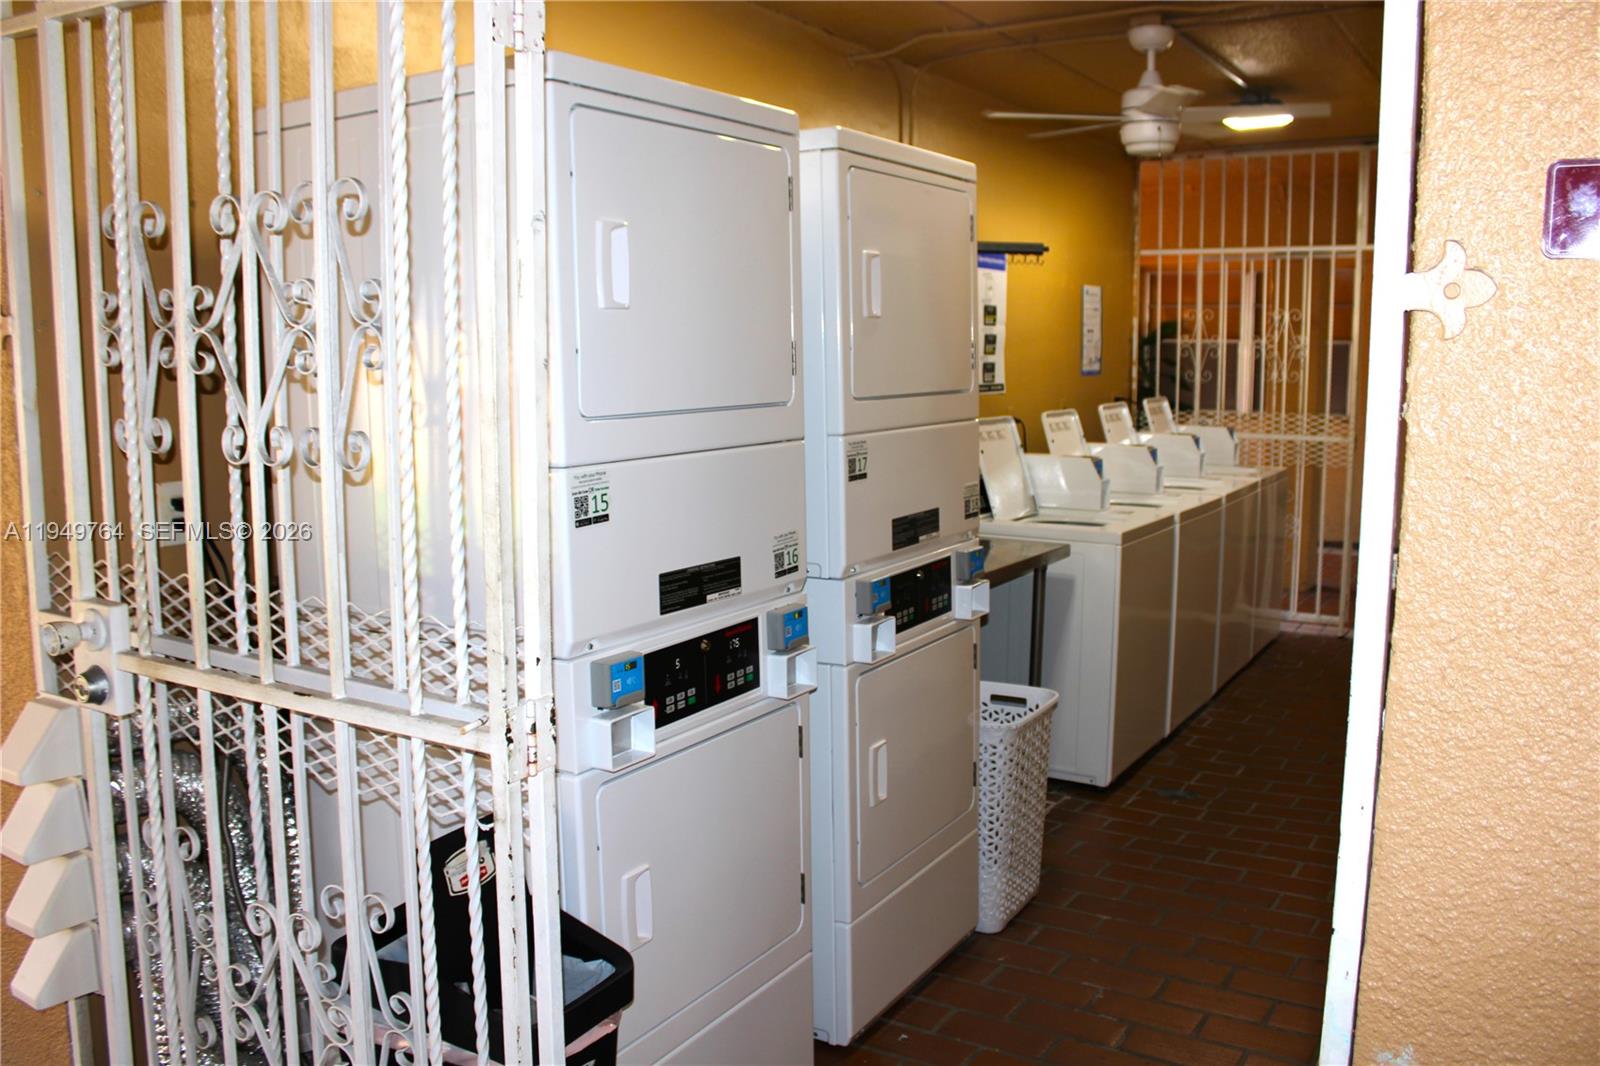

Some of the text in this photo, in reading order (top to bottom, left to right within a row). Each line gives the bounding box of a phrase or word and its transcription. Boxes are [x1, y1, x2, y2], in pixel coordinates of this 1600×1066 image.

[857, 457, 867, 472] 17
[592, 493, 608, 513] 15
[786, 548, 798, 565] 16
